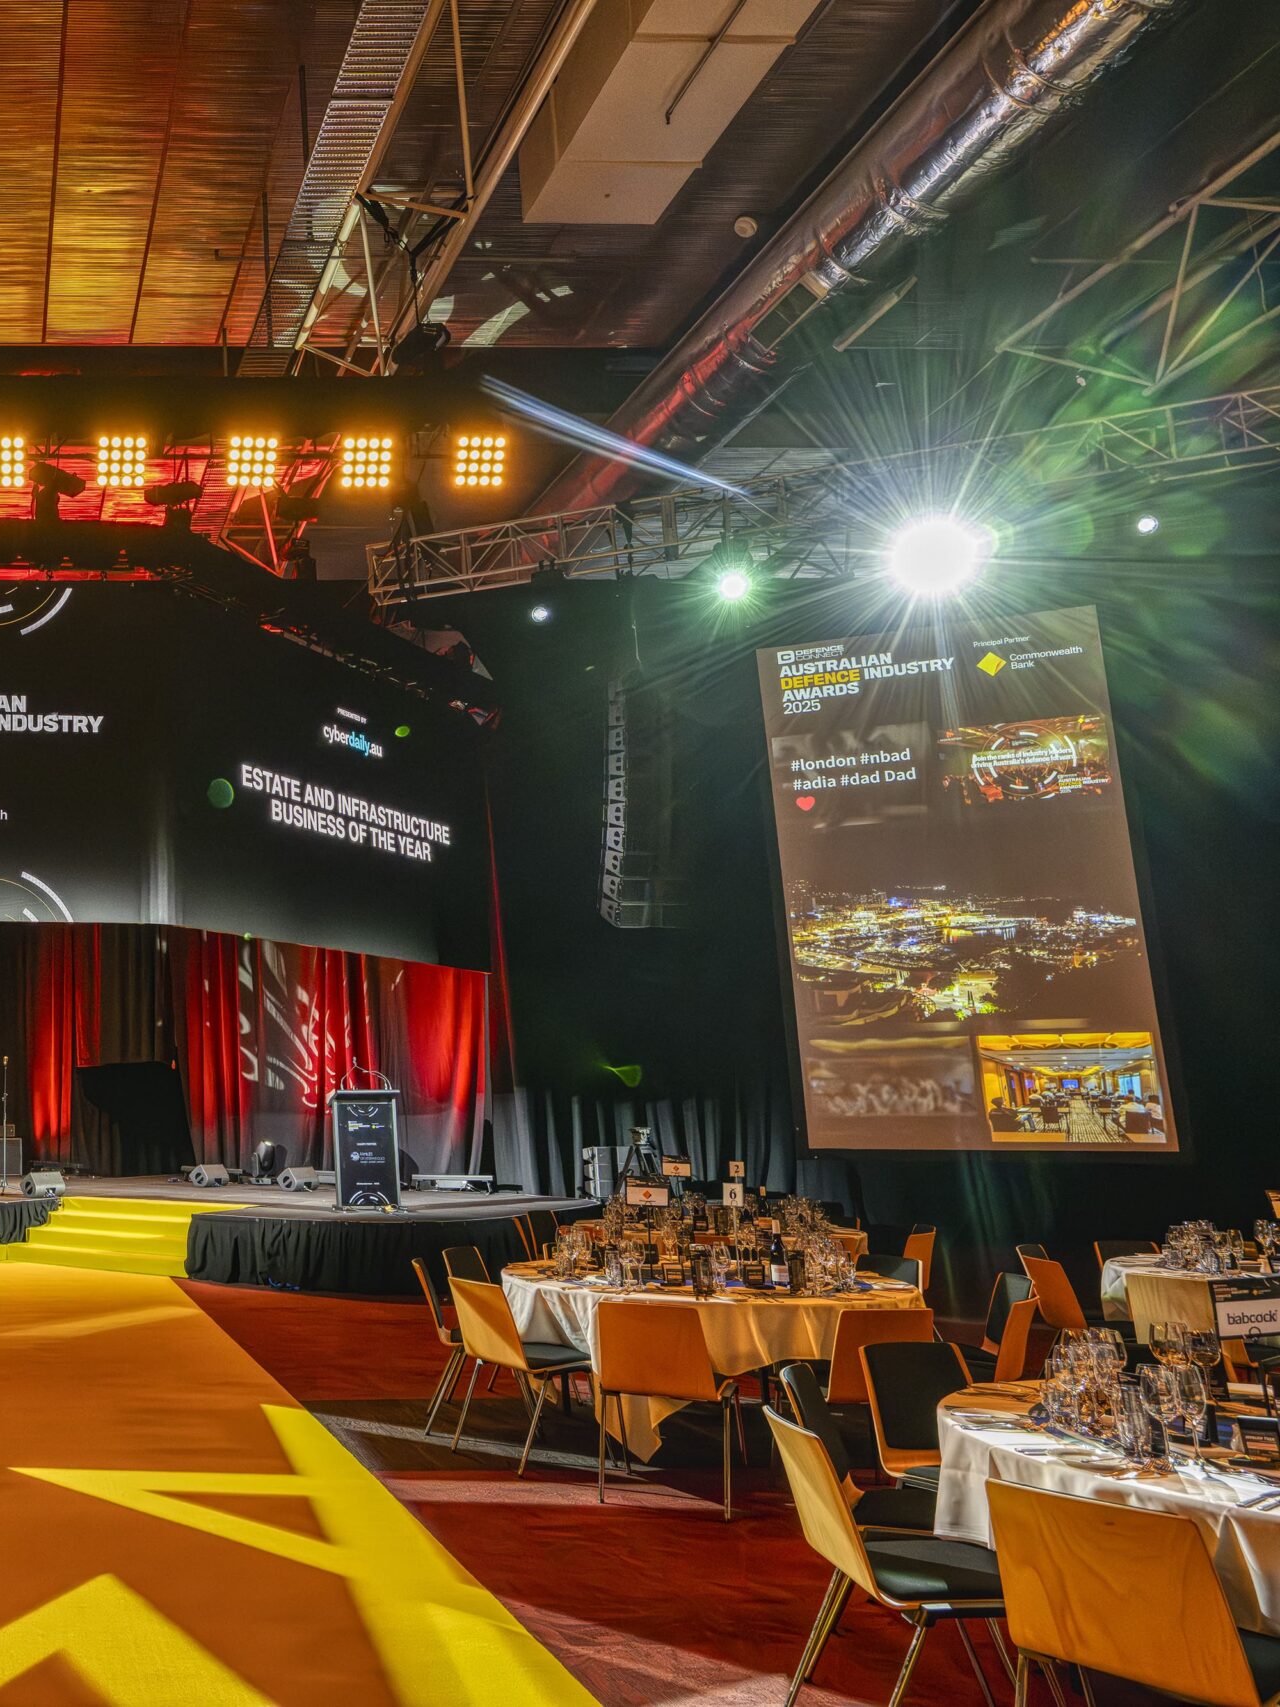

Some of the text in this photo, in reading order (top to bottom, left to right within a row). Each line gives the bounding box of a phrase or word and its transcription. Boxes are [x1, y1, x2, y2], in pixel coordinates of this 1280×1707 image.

[973, 636, 1030, 648] Principal Partner
[796, 644, 844, 656] DEFENCE
[796, 652, 844, 661] CONNECT
[1010, 646, 1082, 660] Commonwealth
[780, 652, 892, 678] AUSTRALIAN
[1011, 660, 1034, 670] Bank
[780, 657, 954, 690] DEFENCE INDUSTRY
[782, 682, 860, 702] AWARDS
[784, 700, 821, 714] 2025
[324, 724, 382, 757] cyberdaily.au
[791, 748, 910, 772] #london #nbad
[793, 767, 916, 790] #adia #dad Dad
[242, 764, 450, 844] ESTATE AND INFRASTRUCTURE
[272, 798, 432, 862] BUSINESS OF THE YEAR
[734, 1164, 740, 1174] 2
[729, 1188, 737, 1200] 6
[1227, 1310, 1277, 1325] babcock
